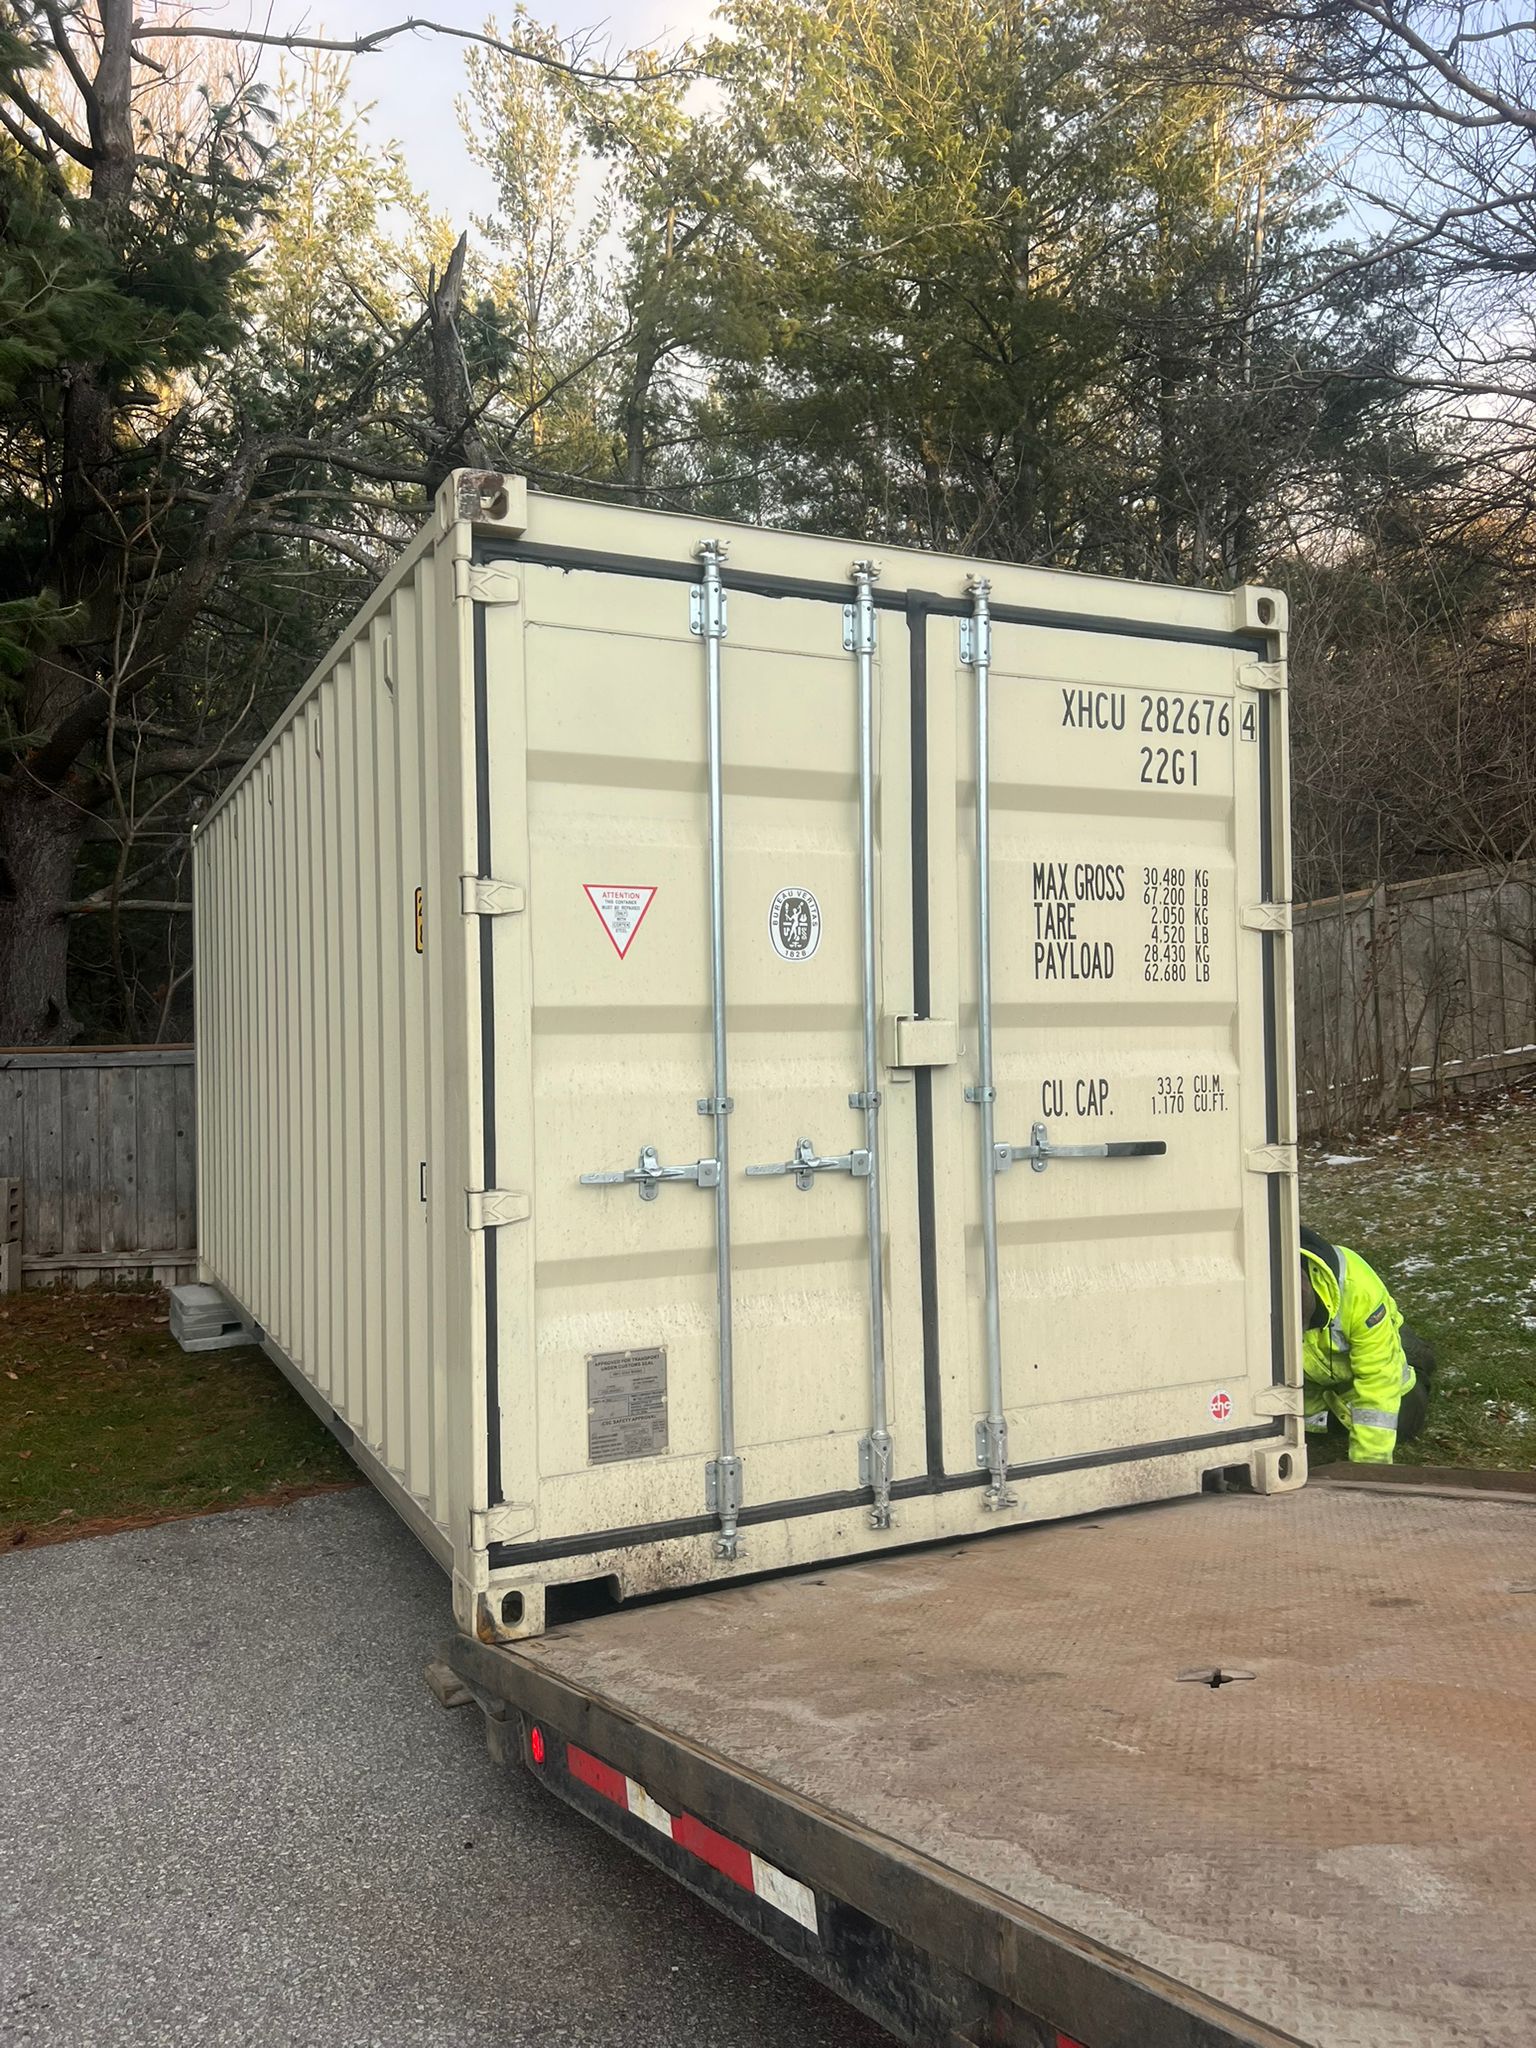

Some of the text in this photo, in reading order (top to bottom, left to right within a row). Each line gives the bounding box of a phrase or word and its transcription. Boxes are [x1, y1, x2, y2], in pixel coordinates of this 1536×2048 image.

[1062, 689, 1256, 740] XHCU 282676 4
[1140, 746, 1198, 787] 22G1
[602, 891, 640, 899] ATTENTION
[1033, 862, 1209, 901] MAX GROSS 30.480 KG
[772, 891, 818, 927] BUREAU VERITAS
[1143, 887, 1209, 907] 67.200 LB
[1034, 902, 1209, 940] TARE 2.050 KG
[1151, 925, 1209, 945] 4.520 LB
[785, 950, 807, 958] 1828
[1034, 942, 1210, 980] PAYLOAD 28.430 KG
[1144, 963, 1210, 982] 62.680 LB
[1042, 1078, 1114, 1117] CU. CAP.
[1157, 1076, 1184, 1095] 33.2
[1151, 1095, 1184, 1115] 1.170
